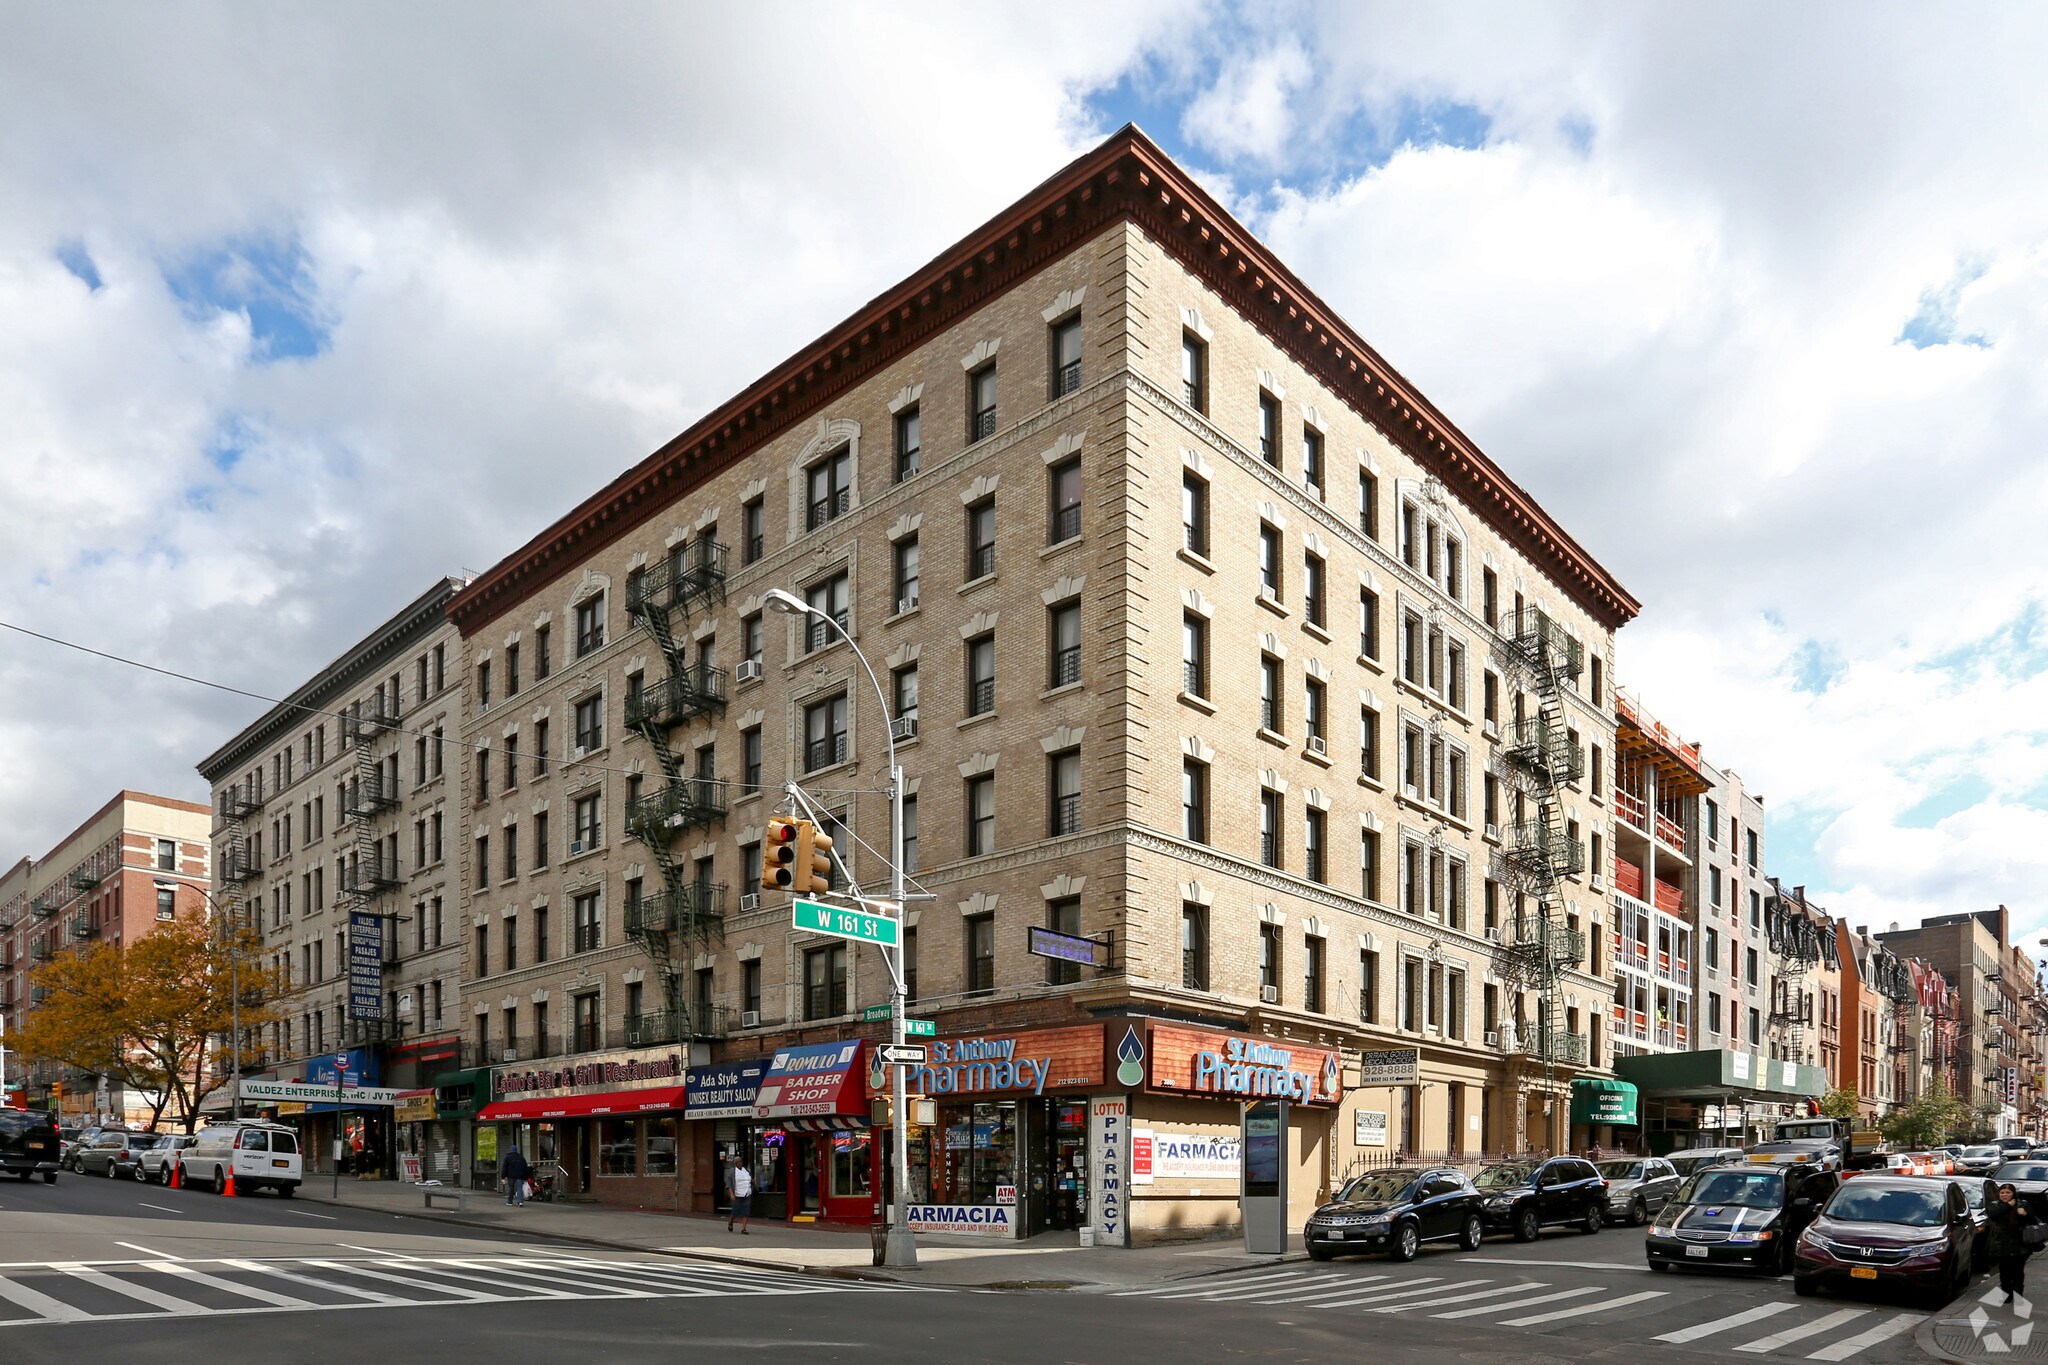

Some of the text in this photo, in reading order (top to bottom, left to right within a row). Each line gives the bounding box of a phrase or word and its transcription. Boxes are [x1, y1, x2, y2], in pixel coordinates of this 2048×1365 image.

[357, 916, 375, 926] VALDEZ
[817, 909, 878, 937] W 161 St
[352, 924, 380, 936] ENTERPRISES
[355, 946, 376, 956] PASAJES
[352, 966, 380, 976] INCOME-TAX
[355, 996, 376, 1006] PASAJES
[356, 1007, 380, 1018] 927-0515
[866, 1007, 890, 1020] Broadway
[906, 1021, 913, 1033] W
[915, 1022, 925, 1033] 161
[887, 1050, 901, 1058] ONE
[932, 1037, 1017, 1064] St Anthony
[1226, 1037, 1292, 1070] St Anthony
[785, 1053, 837, 1072] ROMULO
[495, 1055, 676, 1093] Latino's Bar & Grill Restaurant
[1364, 1065, 1414, 1075] 928-8888
[700, 1074, 716, 1087] Ada
[718, 1072, 738, 1088] Style
[785, 1074, 842, 1088] BARBER
[1195, 1051, 1315, 1105] Pharmacy
[247, 1085, 282, 1096] VALDEZ
[286, 1087, 350, 1100] ENTERPRISES,
[351, 1091, 366, 1100] INC
[372, 1092, 384, 1100] JV
[386, 1092, 396, 1101] TA
[688, 1088, 756, 1104] UNISEX BEAUTY SALON
[787, 1088, 829, 1101] SHOP
[1093, 1102, 1125, 1116] LOTTO
[1158, 1142, 1242, 1160] FARMACIA
[407, 1166, 419, 1174] TAX
[1104, 1117, 1119, 1234] PHARMACY
[998, 1188, 1015, 1197] ATM
[907, 1207, 1008, 1223] ARMACIA
[924, 1223, 950, 1231] INSURANCE
[951, 1224, 966, 1232] PLANS
[967, 1224, 977, 1232] AND
[978, 1224, 987, 1232] WIC
[988, 1225, 1008, 1233] CHECKS
